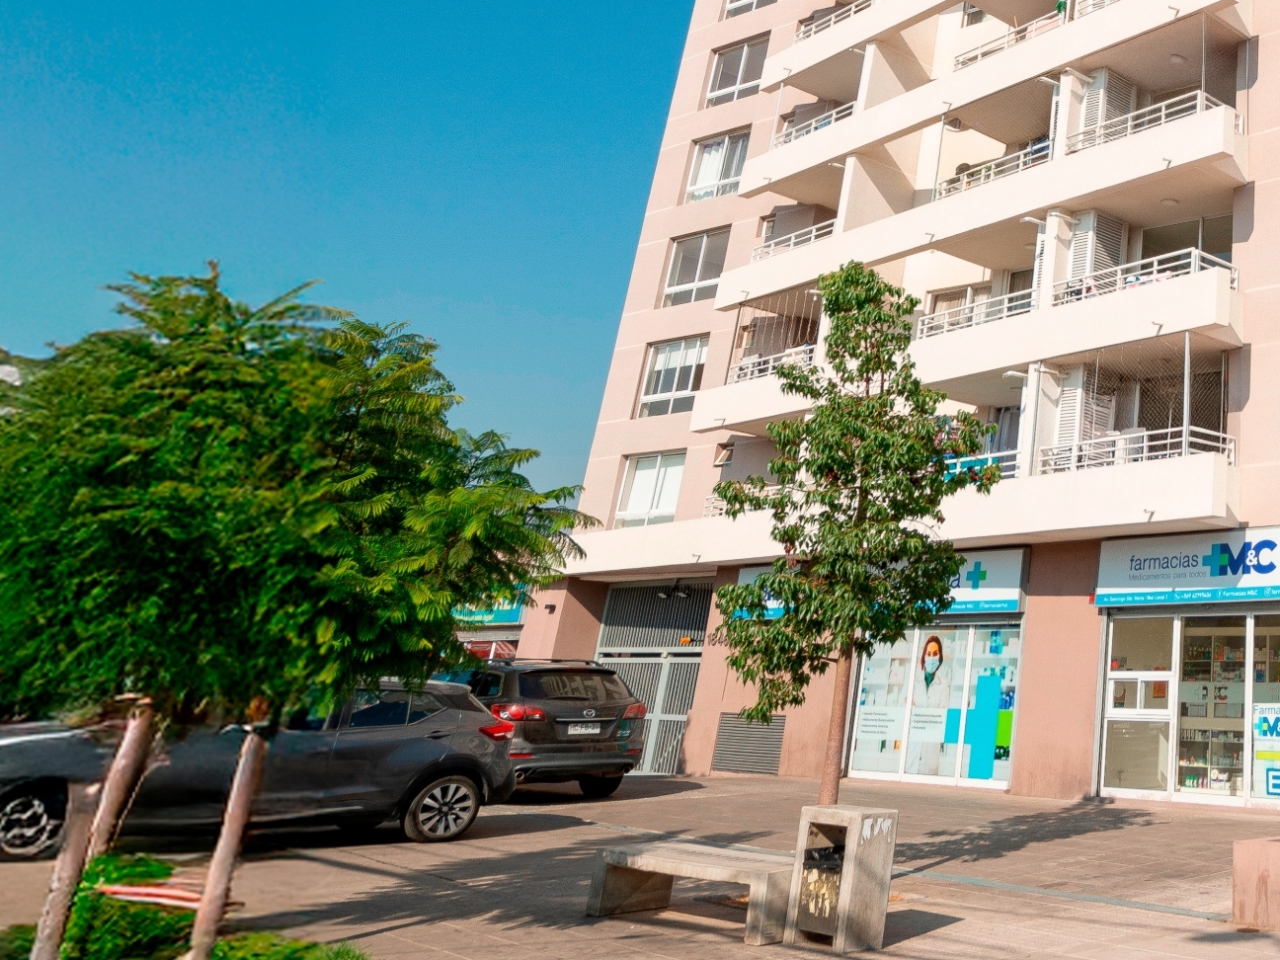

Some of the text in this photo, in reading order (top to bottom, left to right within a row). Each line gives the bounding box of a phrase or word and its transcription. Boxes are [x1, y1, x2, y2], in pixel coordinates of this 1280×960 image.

[1129, 551, 1198, 572] farmacias
[1219, 539, 1278, 576] M&C
[1128, 570, 1207, 581] Medicamentos para todos
